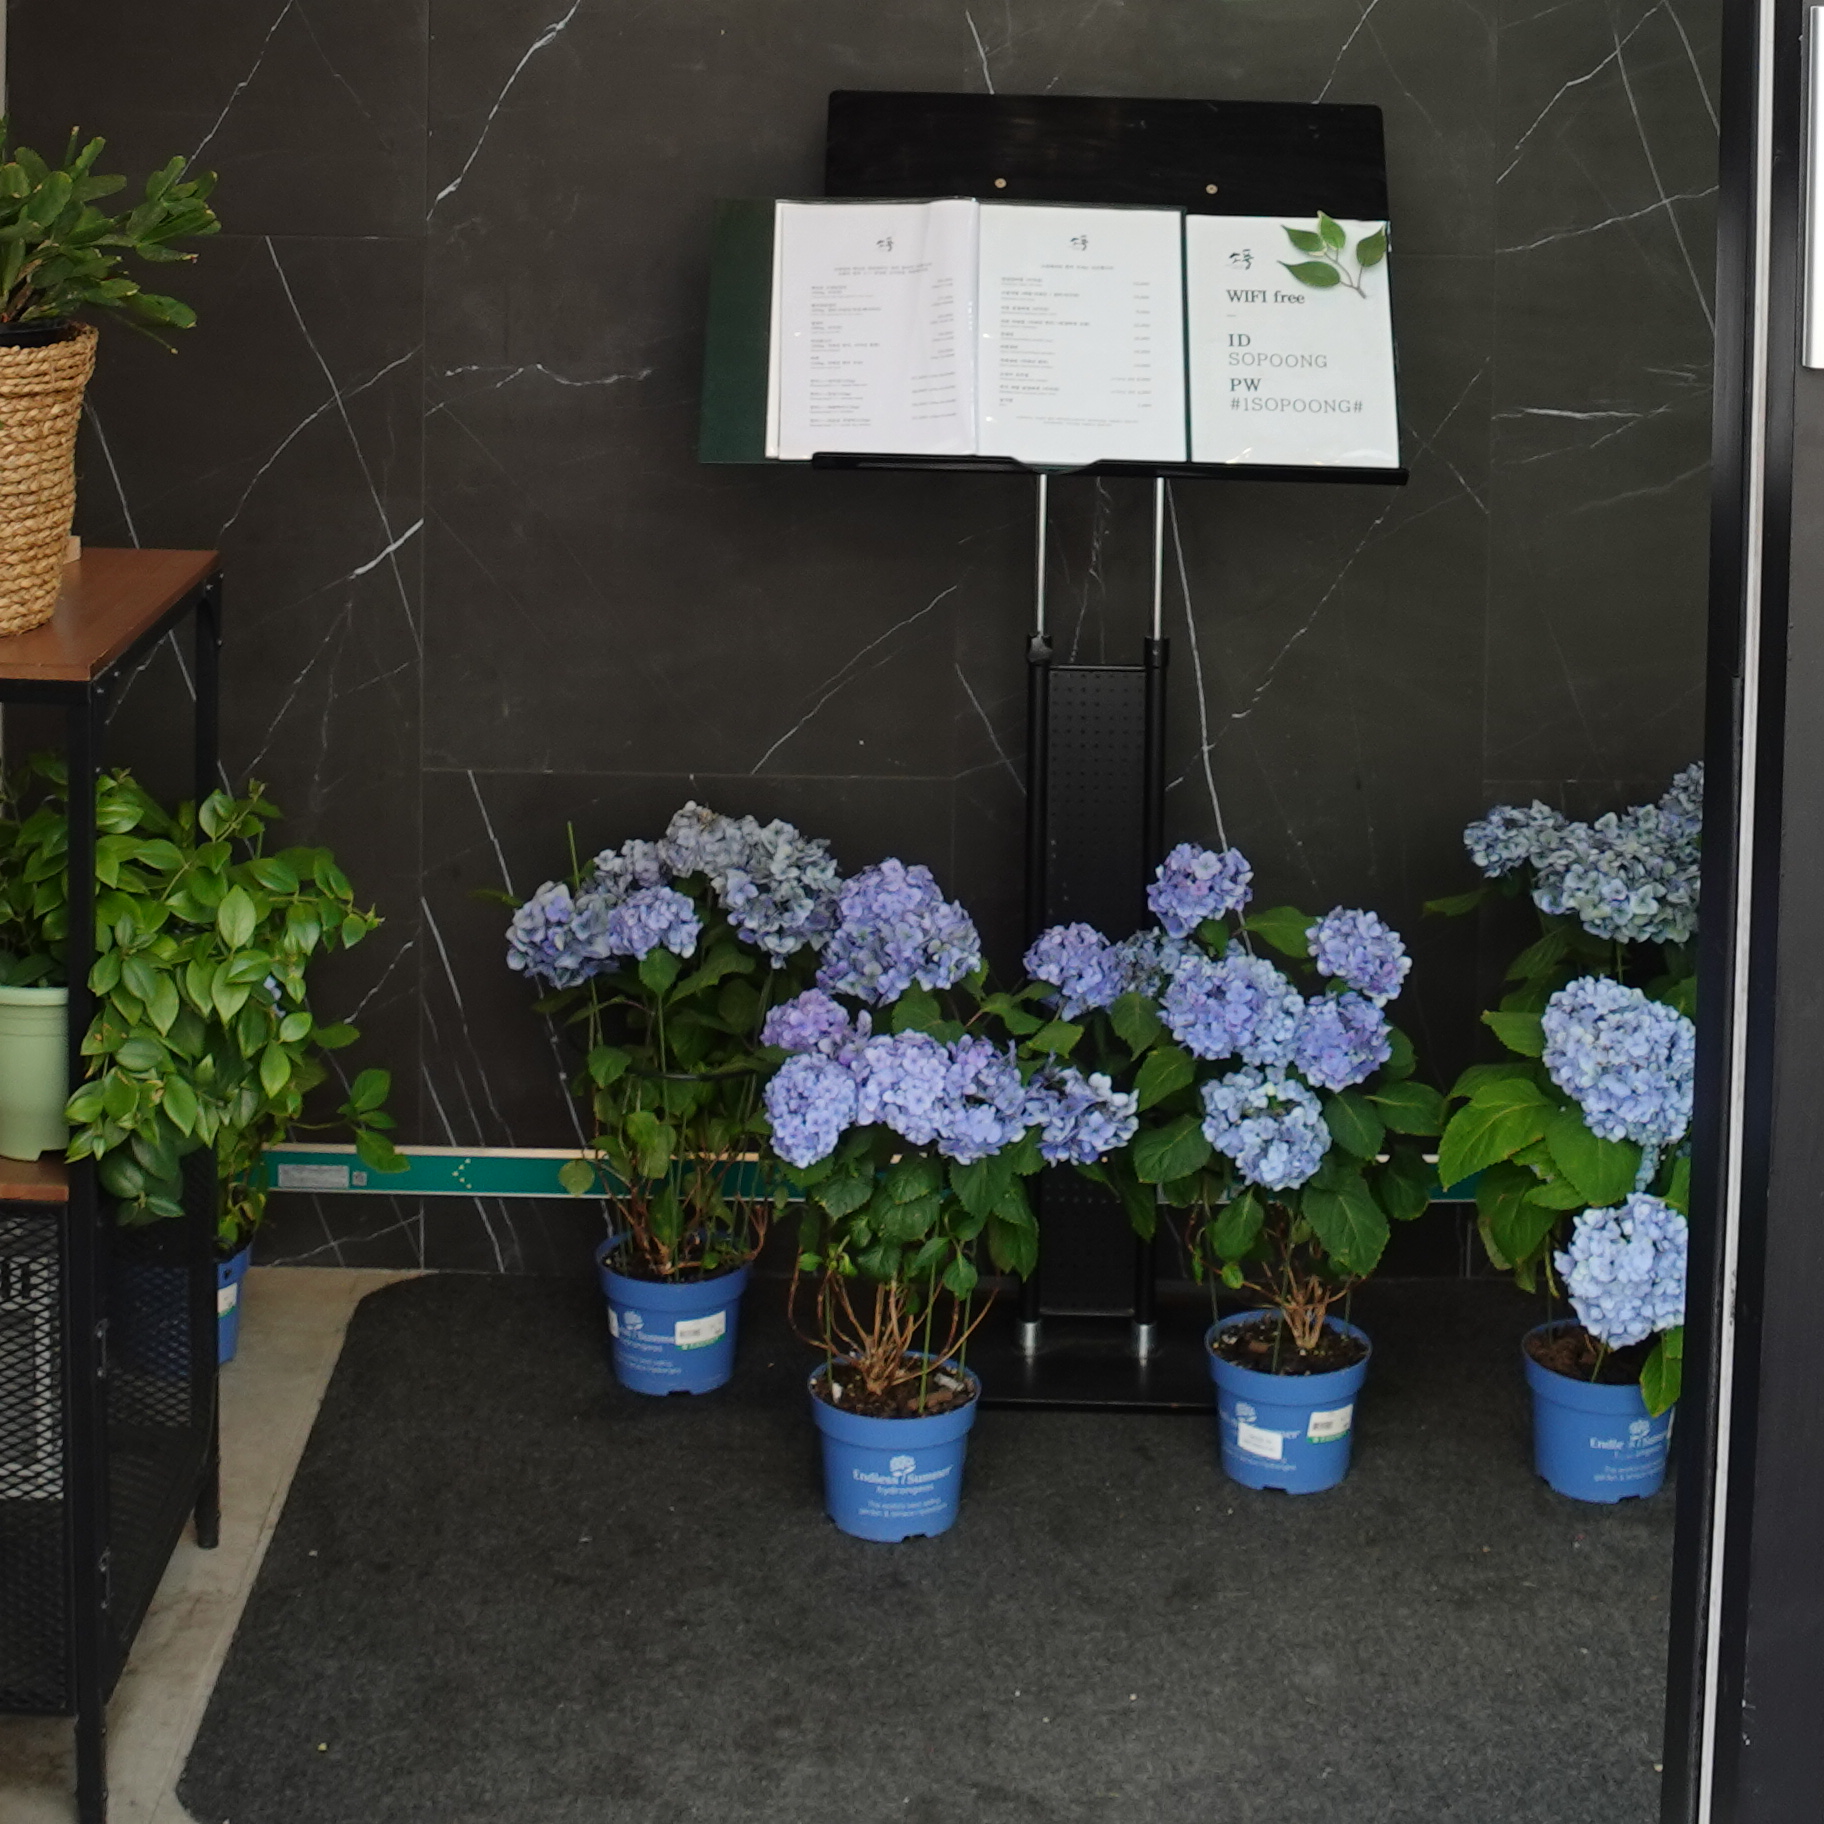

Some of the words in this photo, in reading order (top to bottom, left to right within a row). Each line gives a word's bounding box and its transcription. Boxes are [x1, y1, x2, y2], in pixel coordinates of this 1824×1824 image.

[1226, 289, 1267, 303] WIFI
[1274, 290, 1305, 304] free
[1228, 333, 1251, 347] ID
[1228, 352, 1328, 368] SOPOONG
[1230, 378, 1261, 392] PW
[1230, 397, 1363, 414] #1SOPOONG#
